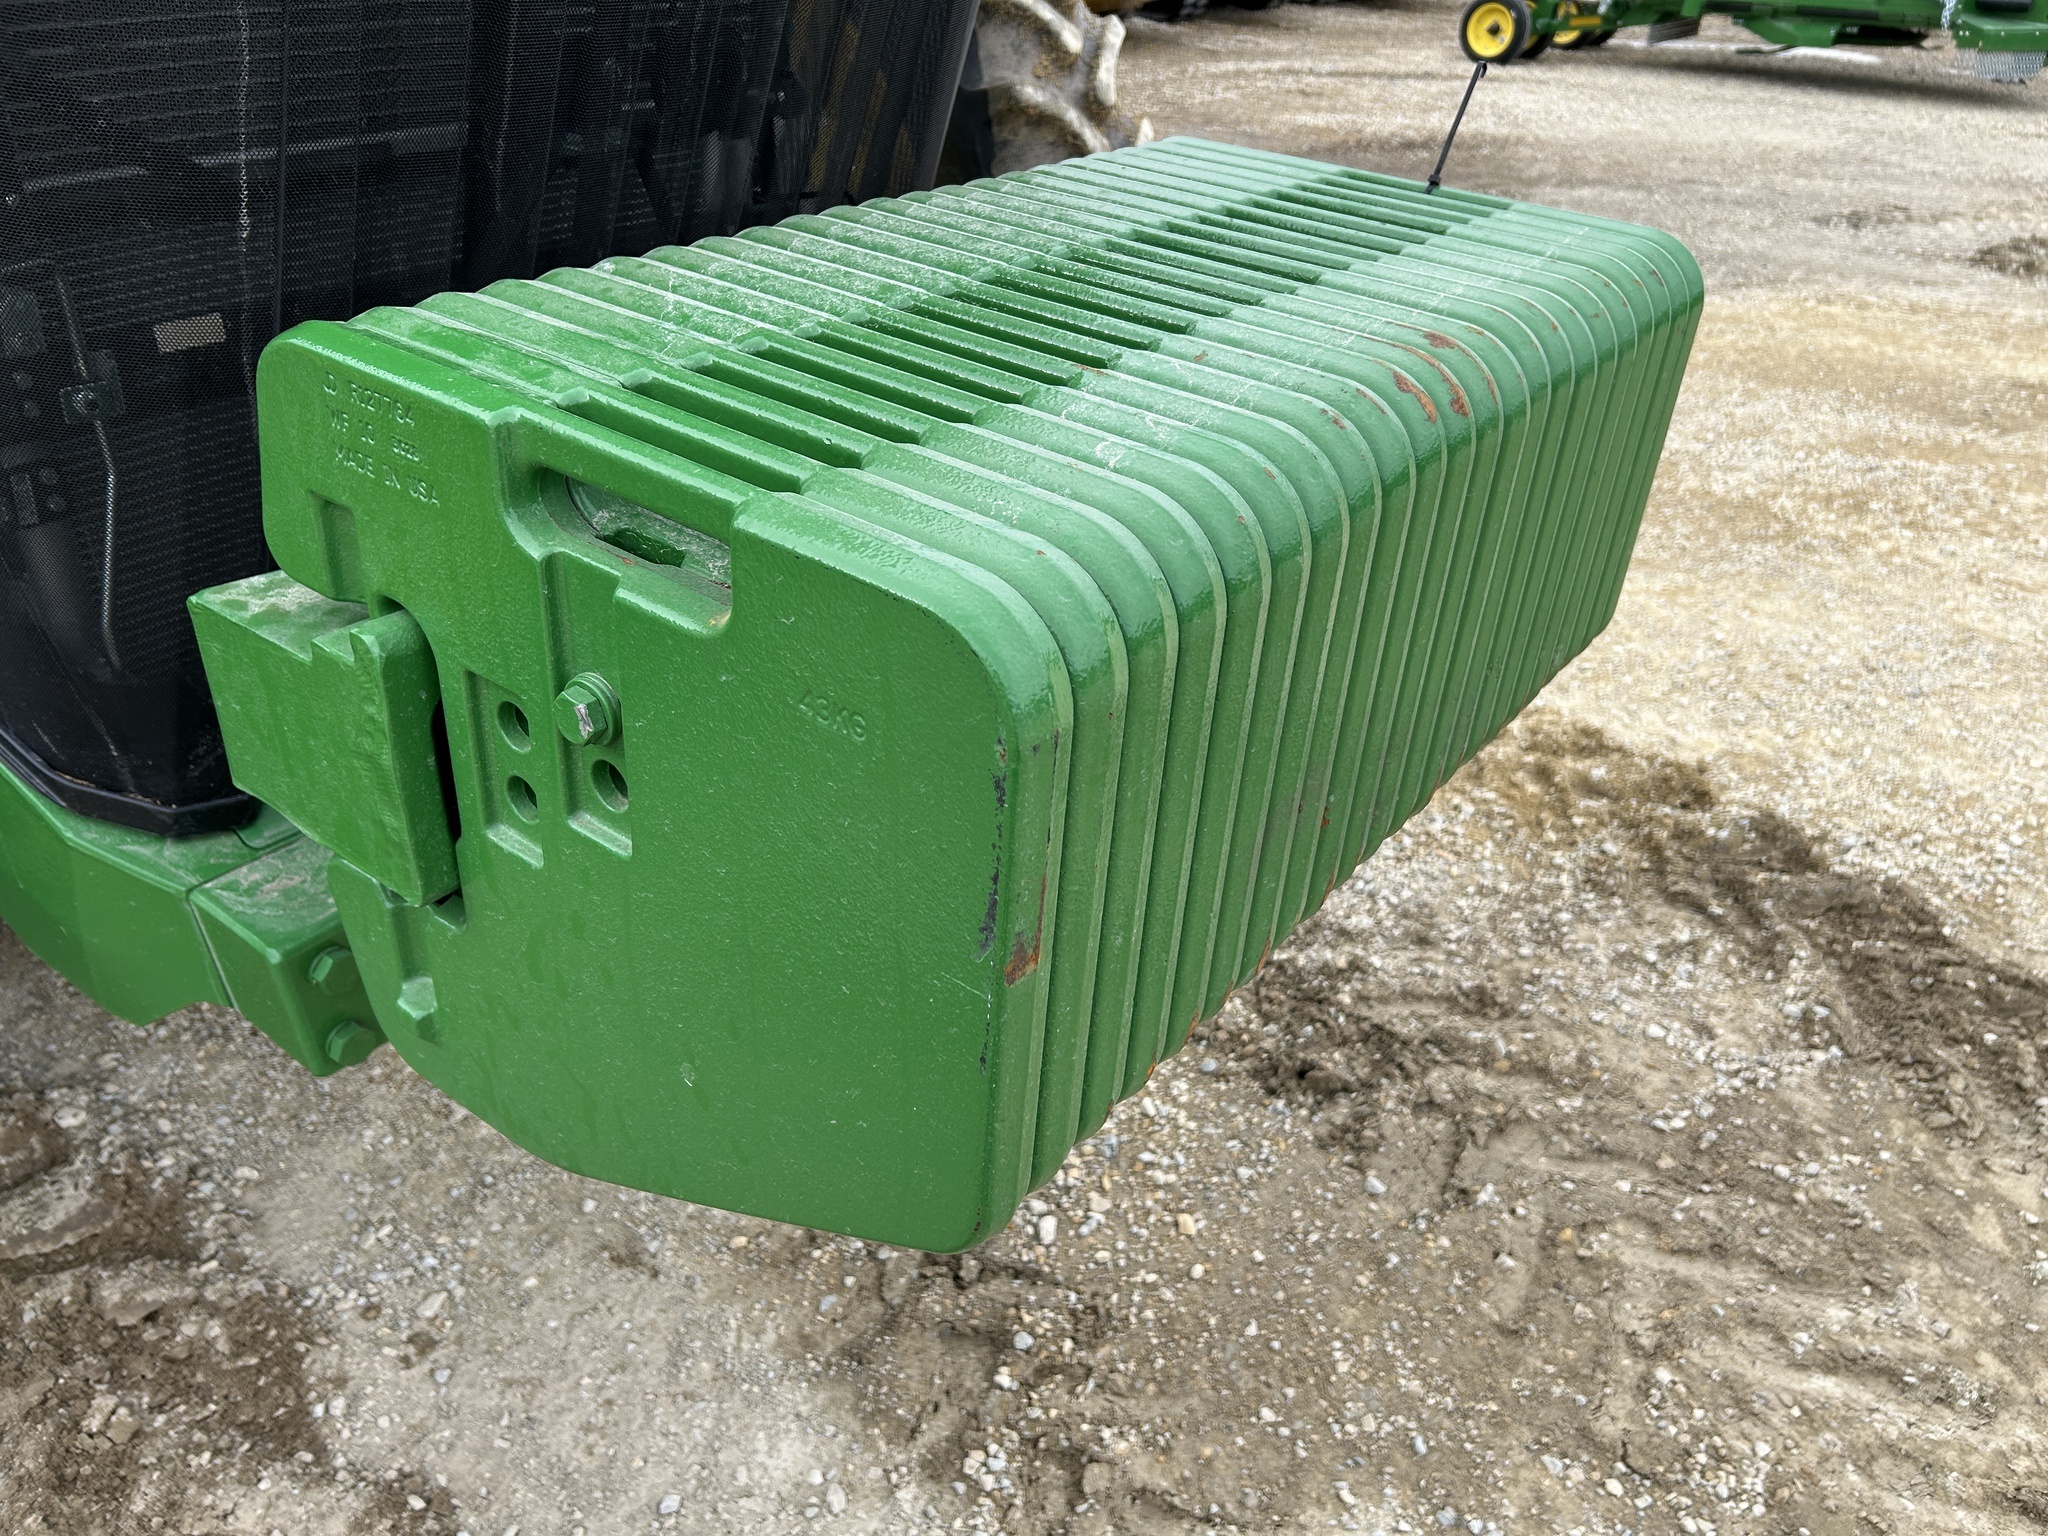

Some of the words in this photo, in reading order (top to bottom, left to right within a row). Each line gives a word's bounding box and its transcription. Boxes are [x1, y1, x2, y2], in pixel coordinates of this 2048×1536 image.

[332, 441, 376, 480] MADE
[382, 462, 401, 490] IN
[406, 474, 440, 508] USA
[799, 689, 867, 742] 43KG
